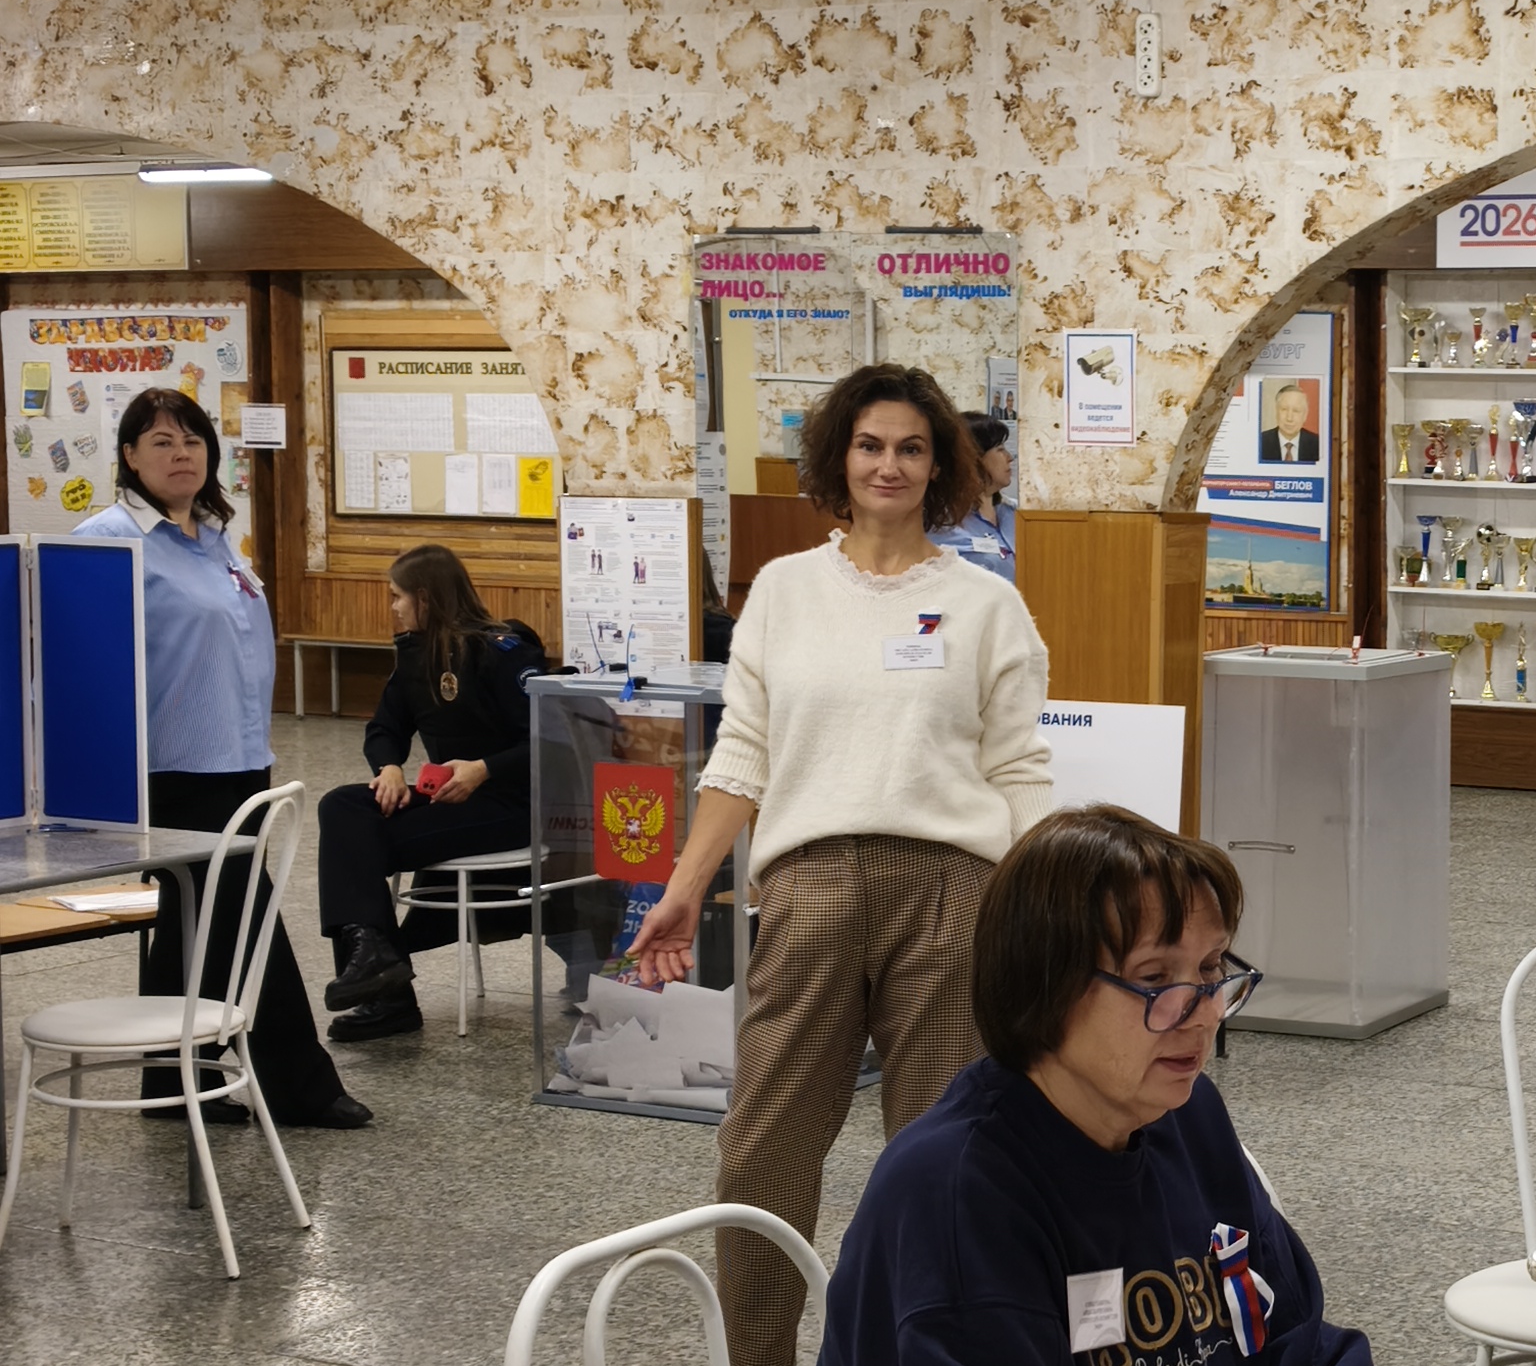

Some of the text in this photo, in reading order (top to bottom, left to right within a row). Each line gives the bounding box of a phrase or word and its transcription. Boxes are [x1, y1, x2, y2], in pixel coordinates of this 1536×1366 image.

[700, 252, 826, 271] ЗНАКОМОЕ
[877, 252, 1010, 275] ОТЛИЧНО
[701, 280, 784, 302] ЛИЦО...
[903, 285, 1012, 299] ВЫГЛЯДИШЬ!
[729, 309, 850, 319] ОТКУДА Я ЕГО ЗНАЮ?
[1259, 343, 1306, 360] БУРГ
[378, 362, 526, 375] РАСПИСАНИЕ ЗАНЯТ
[1274, 480, 1313, 491] БЕГЛОВ
[1228, 489, 1313, 500] Александр Дмитриевич
[1037, 712, 1093, 728] ВАНИЯ
